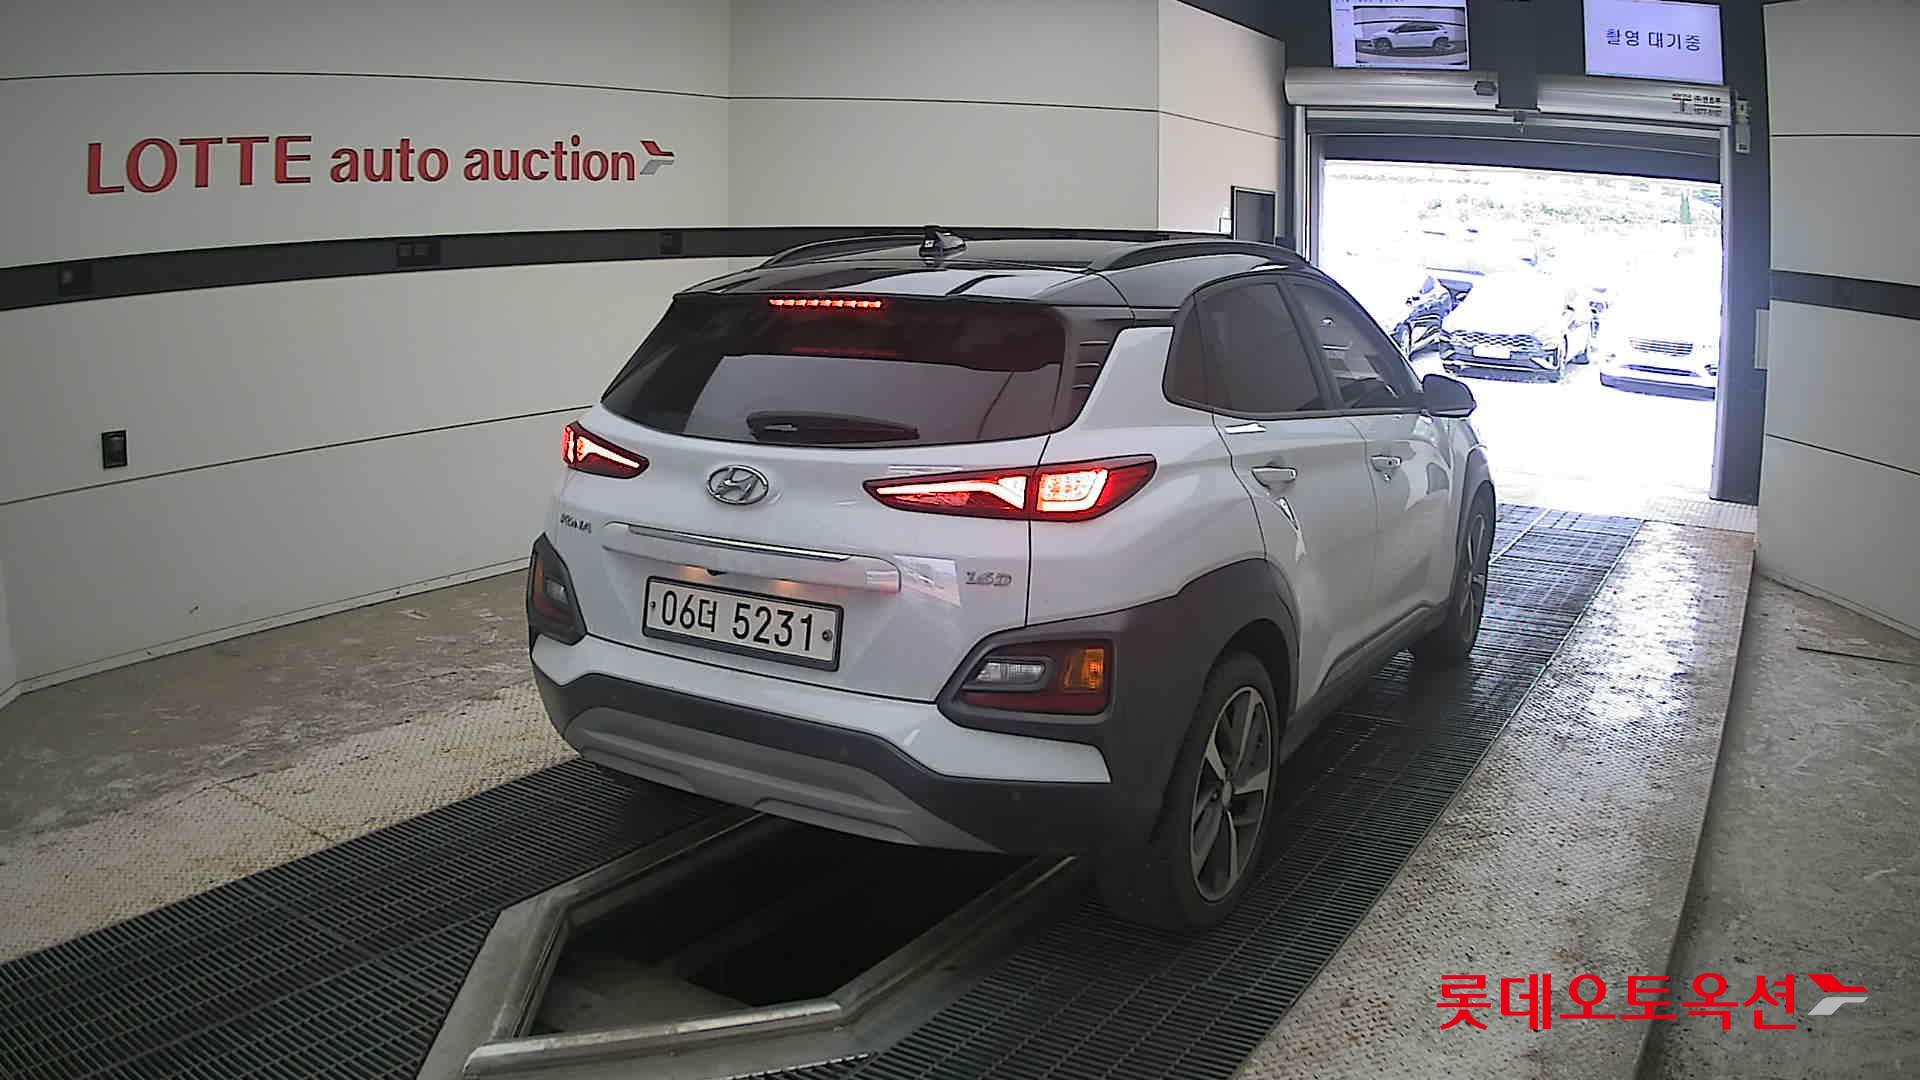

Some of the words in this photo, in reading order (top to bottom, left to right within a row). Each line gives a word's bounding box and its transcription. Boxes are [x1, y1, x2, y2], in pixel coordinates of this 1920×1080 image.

[1607, 28, 1640, 47] 촬영
[1648, 31, 1701, 52] 대기중
[87, 135, 312, 194] LOTTE
[329, 137, 449, 182] auto
[463, 134, 636, 181] auction
[661, 590, 718, 632] 06더
[732, 602, 813, 651] 5231
